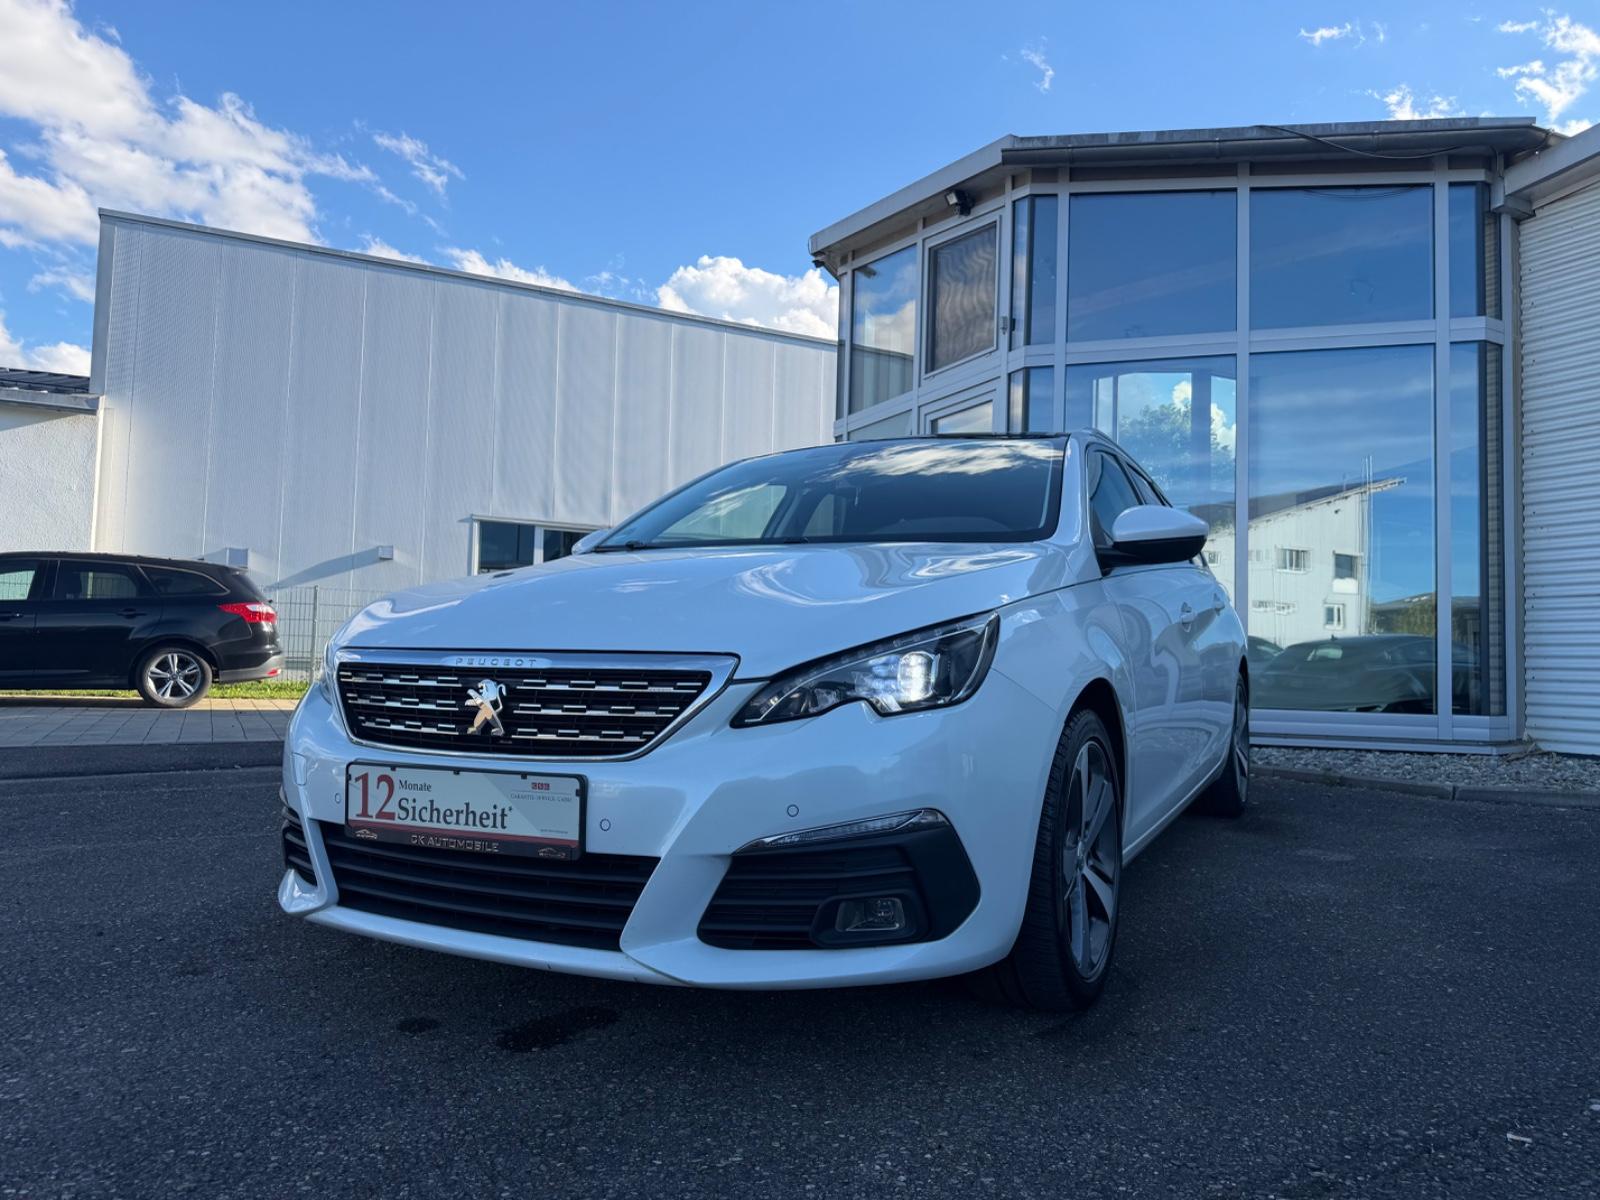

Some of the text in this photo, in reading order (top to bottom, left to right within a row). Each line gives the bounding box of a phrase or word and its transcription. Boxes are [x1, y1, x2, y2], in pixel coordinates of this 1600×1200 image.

[455, 657, 537, 667] PEUGEOT
[399, 779, 432, 793] Monate
[354, 772, 396, 821] 12
[427, 836, 500, 853] AUTOMOBILE
